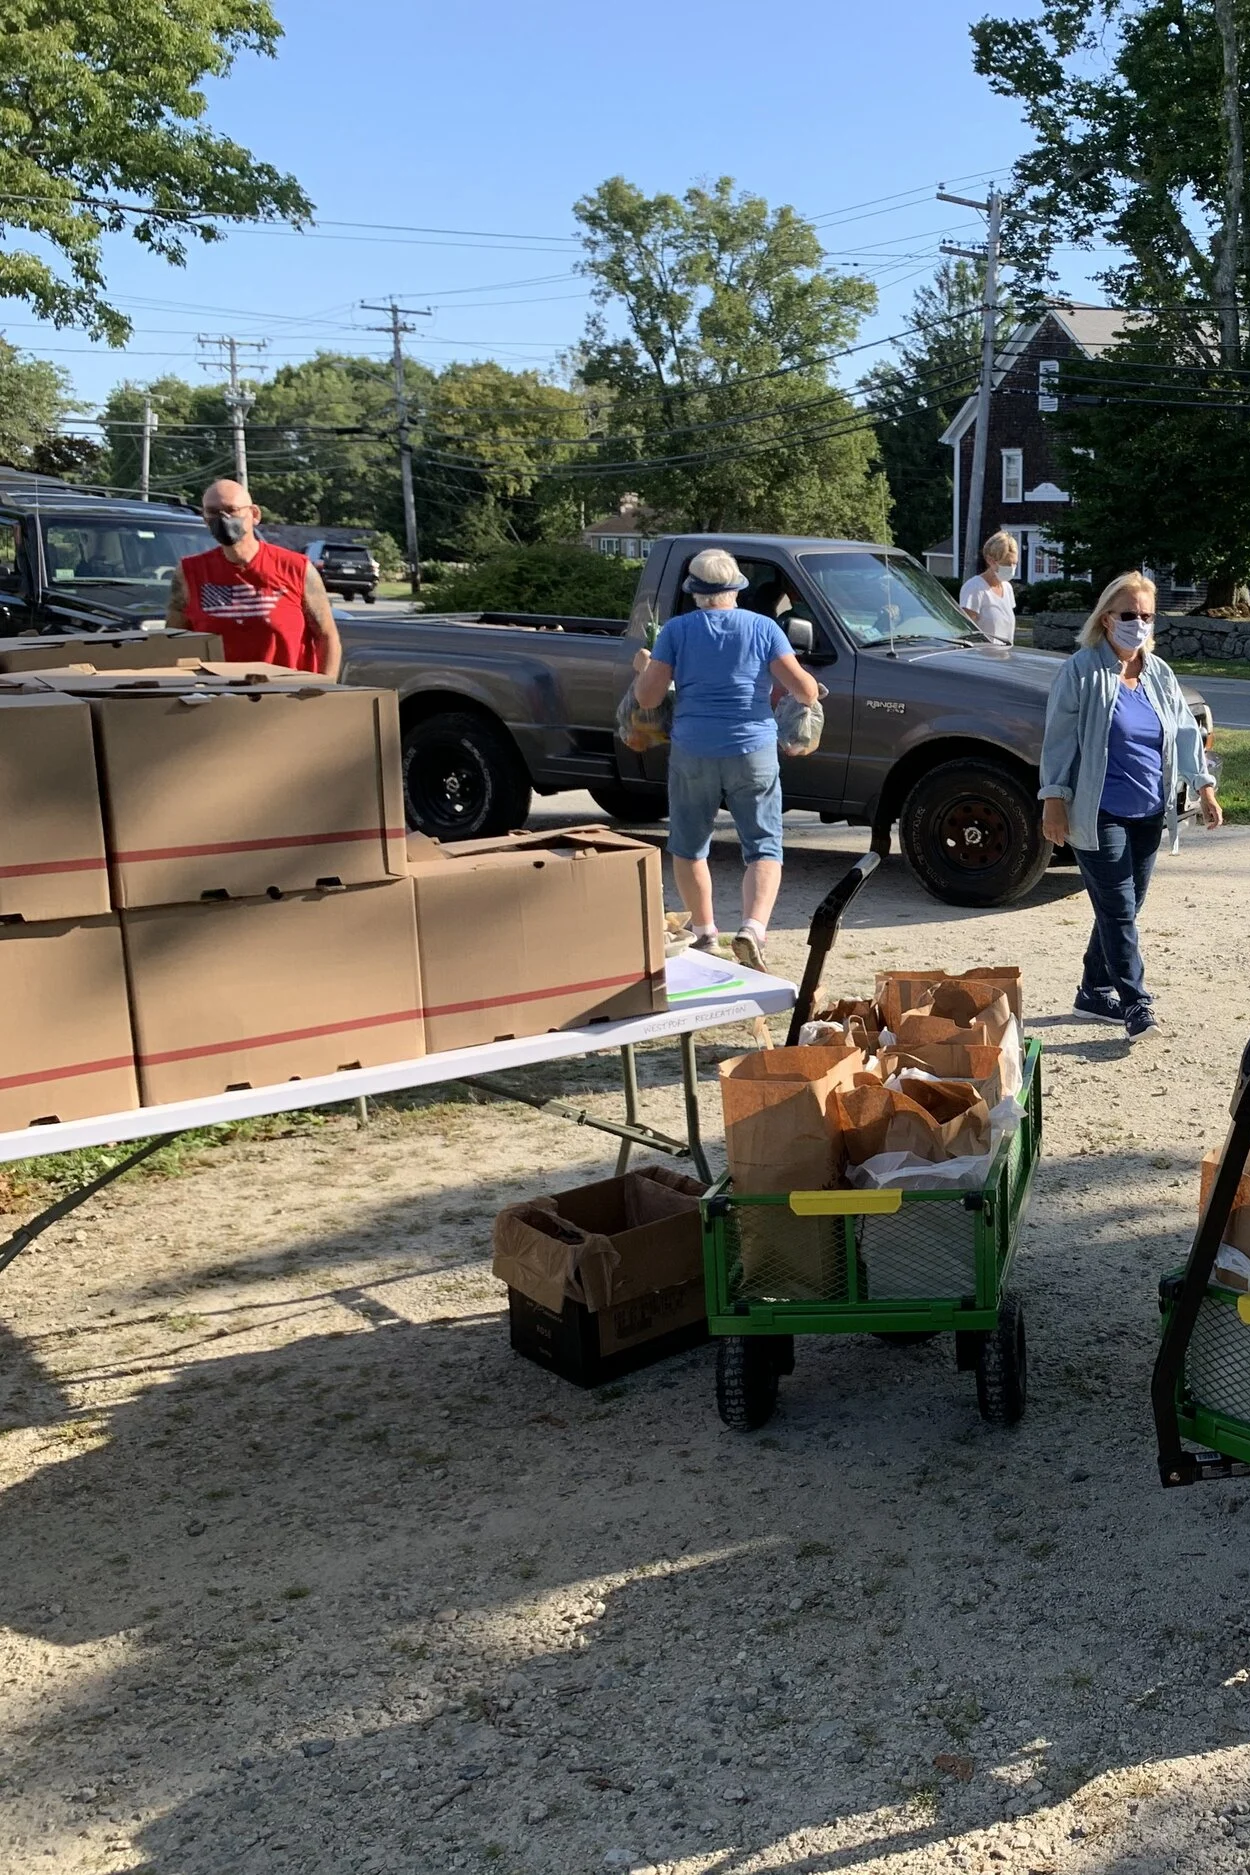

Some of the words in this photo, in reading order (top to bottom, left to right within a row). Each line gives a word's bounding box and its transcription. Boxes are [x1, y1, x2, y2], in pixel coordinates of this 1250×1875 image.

[866, 700, 906, 710] RANGER
[643, 1018, 688, 1035] WESTPORT
[695, 1004, 747, 1023] RECREATION
